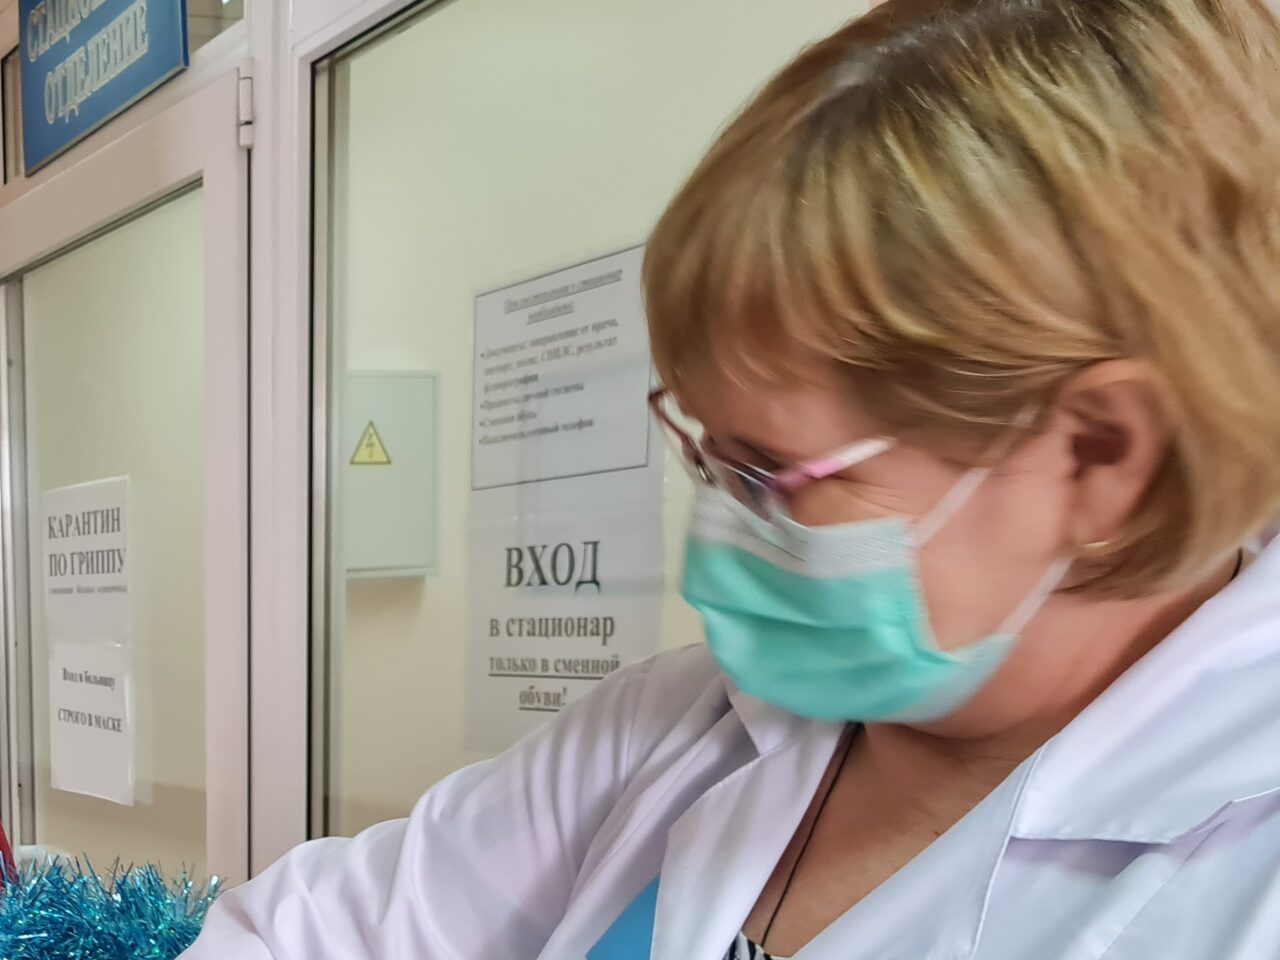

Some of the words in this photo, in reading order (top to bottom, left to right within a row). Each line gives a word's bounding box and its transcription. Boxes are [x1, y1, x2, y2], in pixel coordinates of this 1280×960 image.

[45, 0, 149, 124] ОТДЕЛЕНИЕ
[48, 507, 121, 539] КАРАНТИН
[49, 553, 68, 576] ПО
[70, 547, 127, 575] ГРИППУ
[504, 540, 601, 594] ВХОД
[489, 618, 500, 637] в
[505, 616, 616, 646] стационар
[489, 657, 537, 673] только
[541, 658, 550, 673] в
[554, 654, 620, 675] сменной
[58, 708, 87, 726] СТРОГО
[88, 713, 93, 727] В
[94, 714, 123, 733] МАСКЕ
